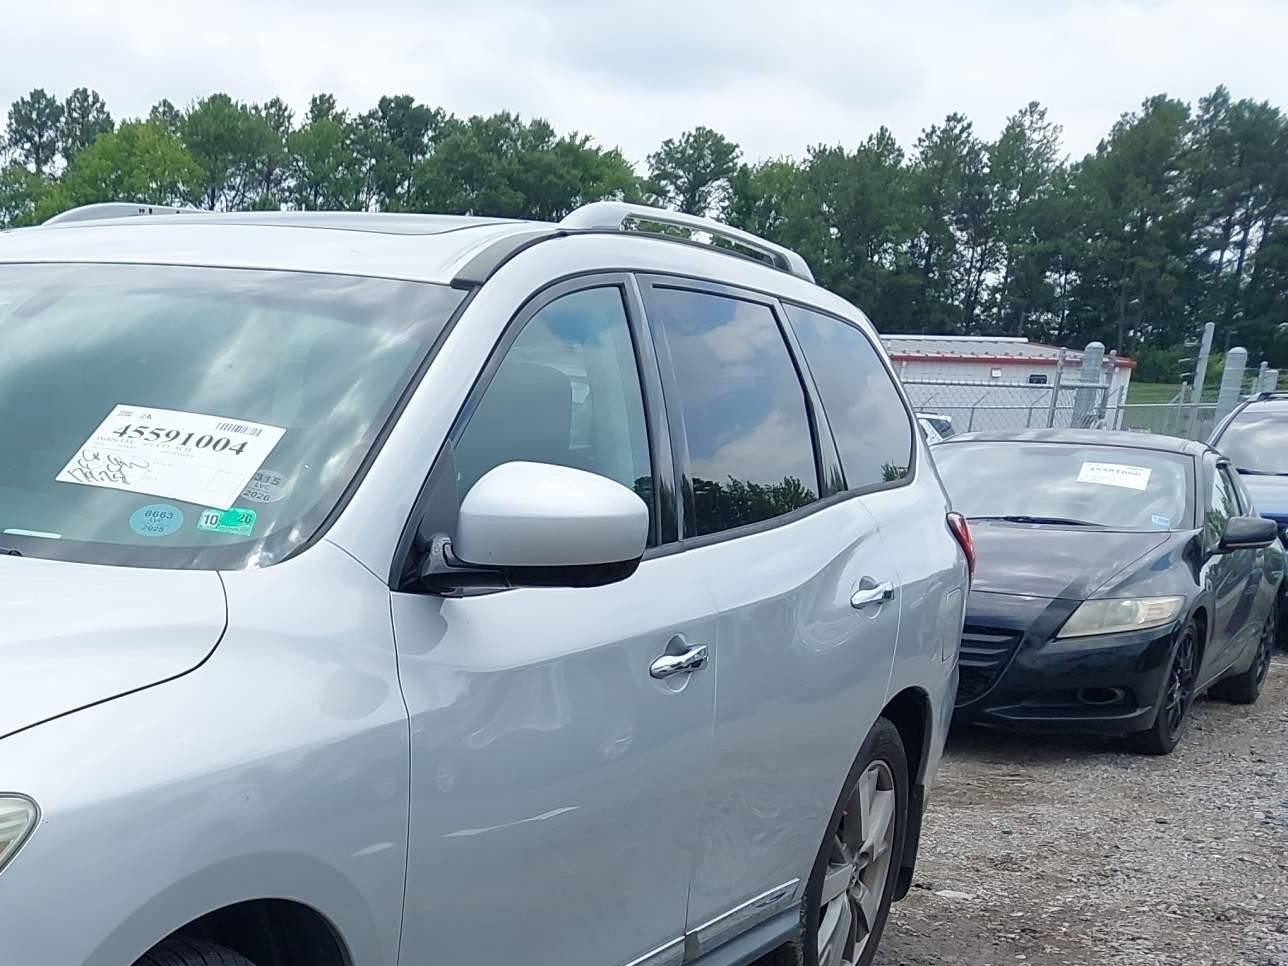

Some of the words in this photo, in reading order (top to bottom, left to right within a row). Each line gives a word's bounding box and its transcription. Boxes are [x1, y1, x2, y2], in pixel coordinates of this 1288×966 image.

[113, 423, 249, 456] 45591004
[243, 489, 271, 501] 2026
[204, 514, 219, 526] 10
